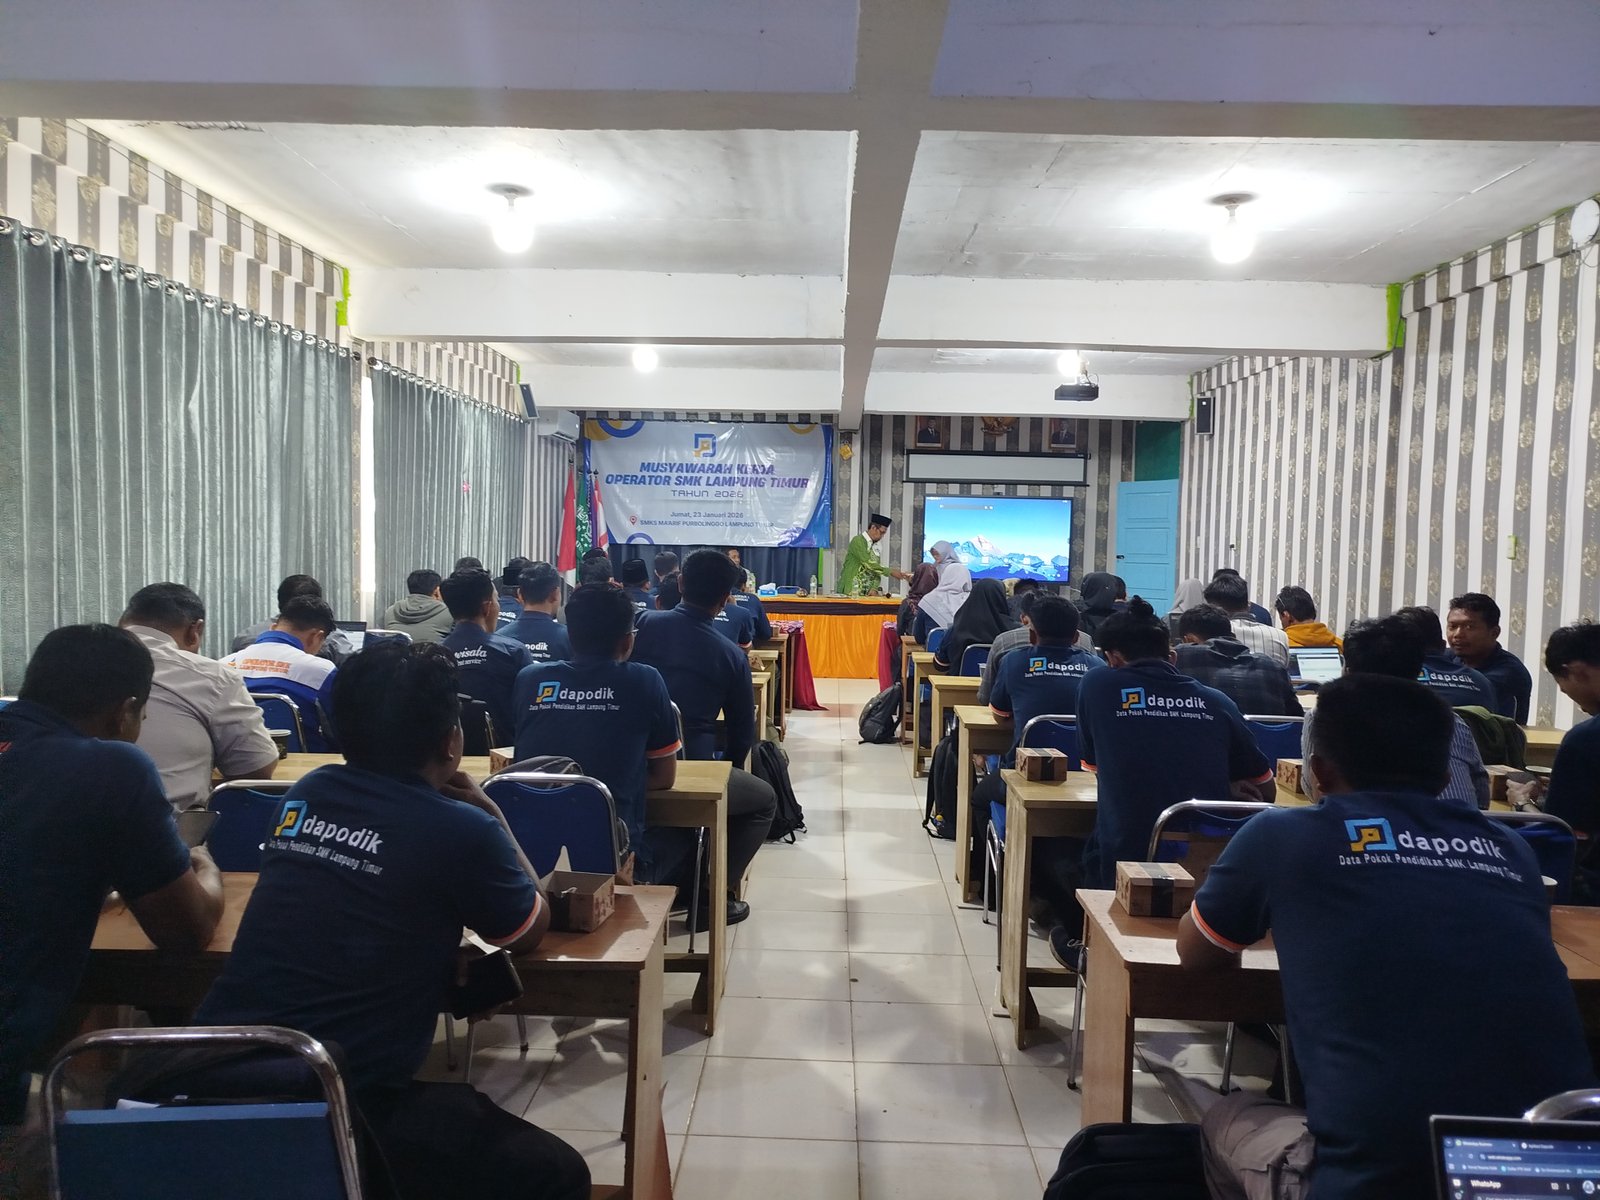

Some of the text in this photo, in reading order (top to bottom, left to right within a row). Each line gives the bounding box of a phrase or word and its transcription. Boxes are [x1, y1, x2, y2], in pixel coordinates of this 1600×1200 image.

[640, 462, 733, 475] MUSYAWARAH
[605, 474, 811, 489] OPERATOR SMK LAMPUNG TIMUR
[671, 489, 744, 498] TAHUN 2026
[1047, 661, 1088, 672] dapodik
[1430, 672, 1475, 684] dapodik
[560, 687, 614, 702] dapodik
[1147, 694, 1207, 709] dapodik
[1181, 711, 1202, 720] Lampung
[1202, 712, 1214, 720] Timur
[302, 815, 383, 854] dapodik
[1398, 831, 1506, 861] dapodik
[290, 840, 316, 855] Pendidikan
[316, 845, 331, 859] SMK
[329, 850, 361, 870] Lampung
[361, 859, 383, 875] Timur
[1339, 855, 1362, 866] Data
[1364, 853, 1391, 864] Pokok
[1395, 854, 1444, 867] Pendidikan
[1446, 858, 1467, 869] SMK
[1468, 860, 1504, 877] Lampung
[1470, 1179, 1502, 1189] WhatsApp
